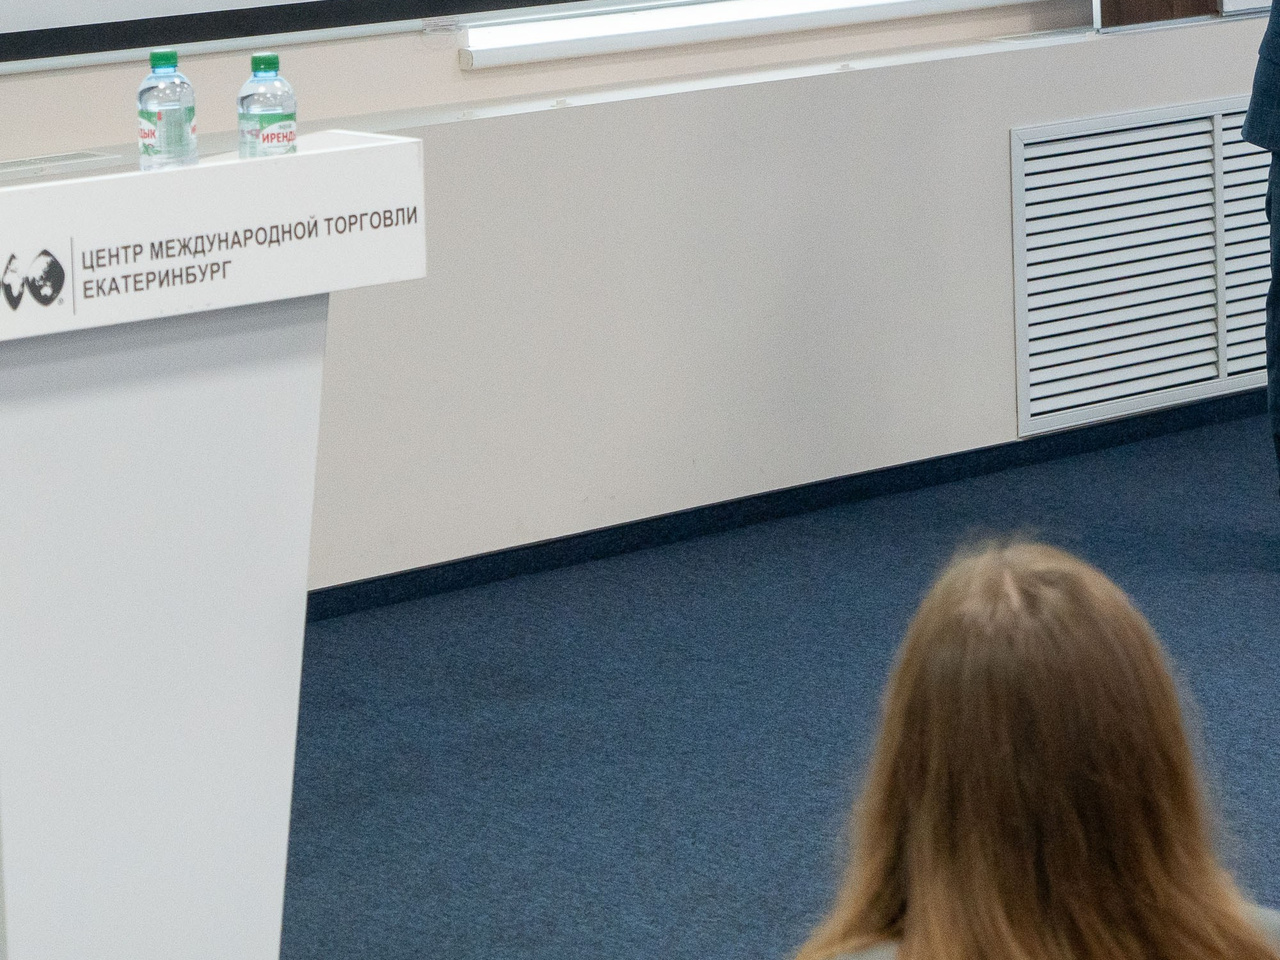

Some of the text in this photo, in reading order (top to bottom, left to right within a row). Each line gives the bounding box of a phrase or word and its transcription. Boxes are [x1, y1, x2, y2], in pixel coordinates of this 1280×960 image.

[82, 206, 417, 272] ЦЕНТР МЕЖДУНАРОДНОЙ ТОРГОВЛИ
[82, 261, 232, 299] ЕКАТЕРИНБУРГ
